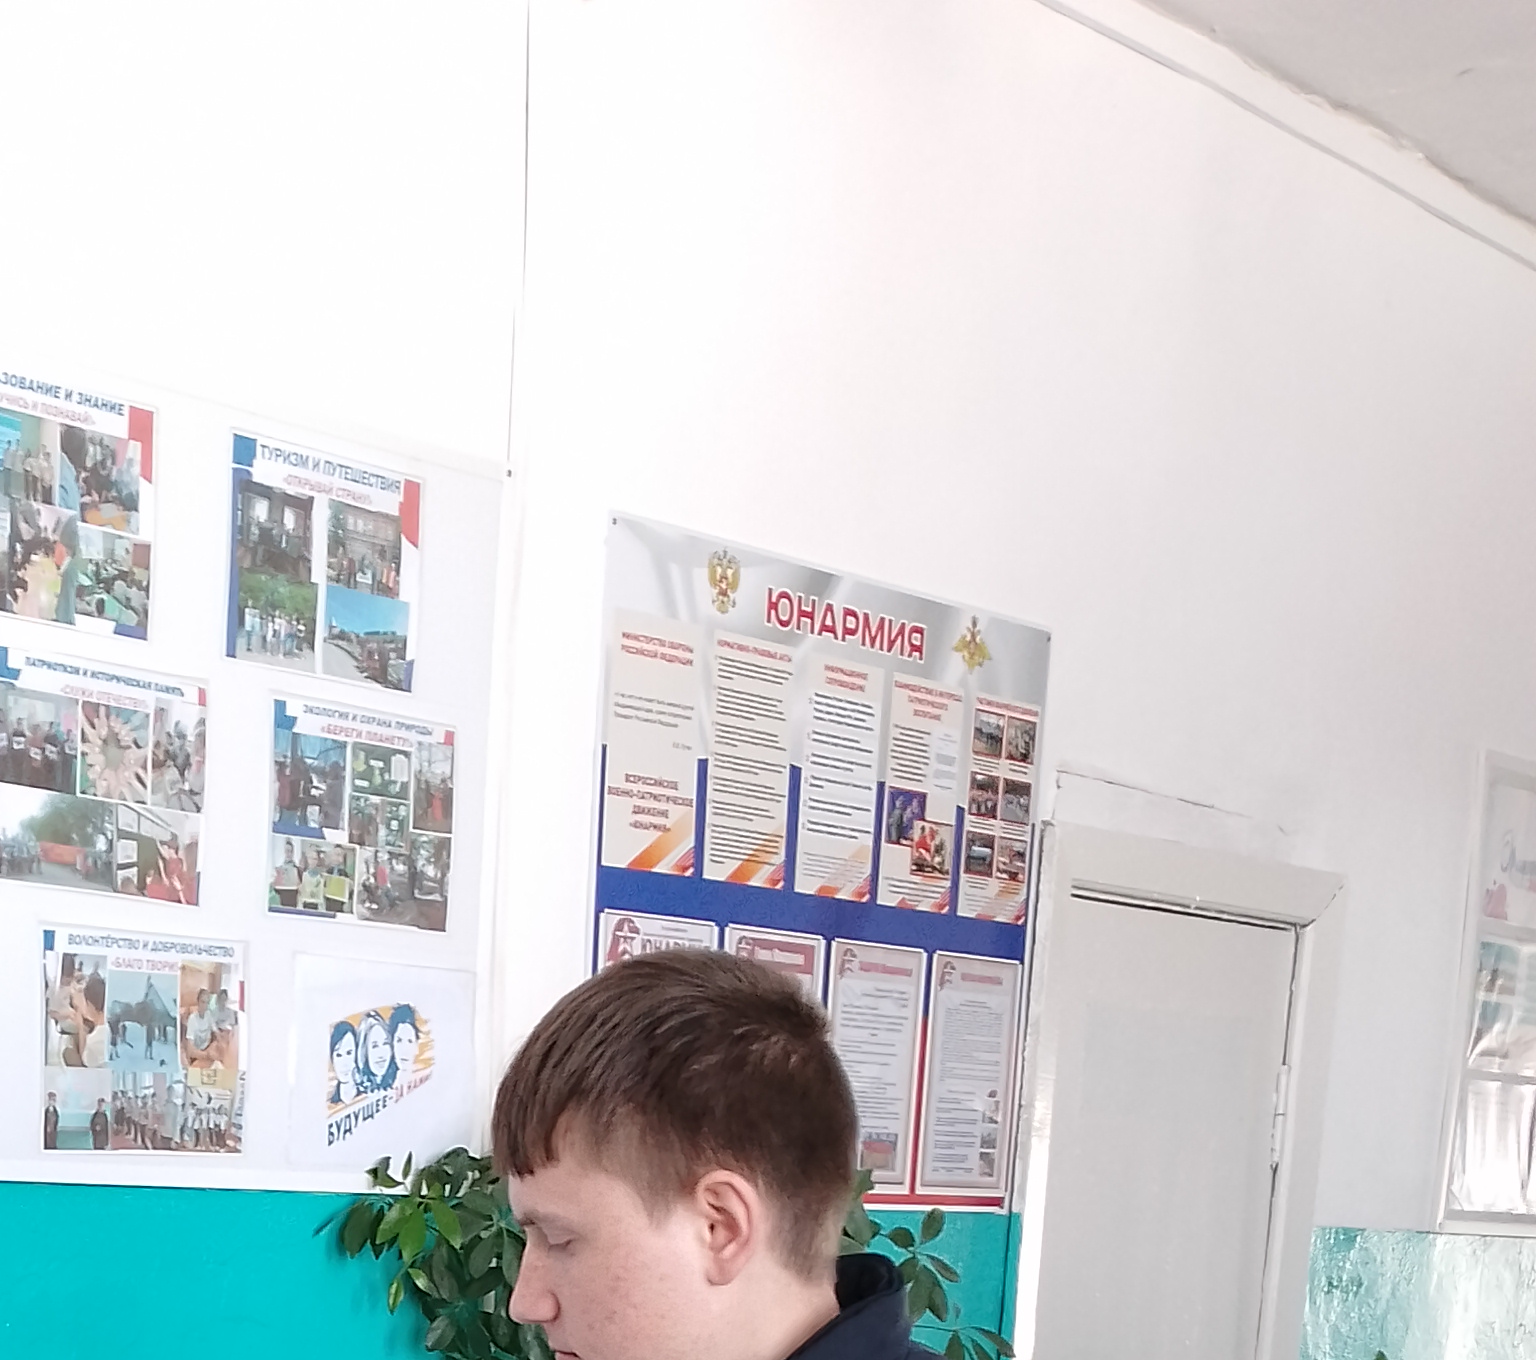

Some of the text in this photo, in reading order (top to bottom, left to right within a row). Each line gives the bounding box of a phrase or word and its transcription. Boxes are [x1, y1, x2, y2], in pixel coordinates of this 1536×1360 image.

[64, 388, 74, 402] И
[77, 392, 125, 416] ЗНАНИЕ
[260, 443, 401, 496] ТУРИЗМ И ПУТЕШЕСТВИЯ
[765, 585, 926, 663] ЮНАРМИЯ
